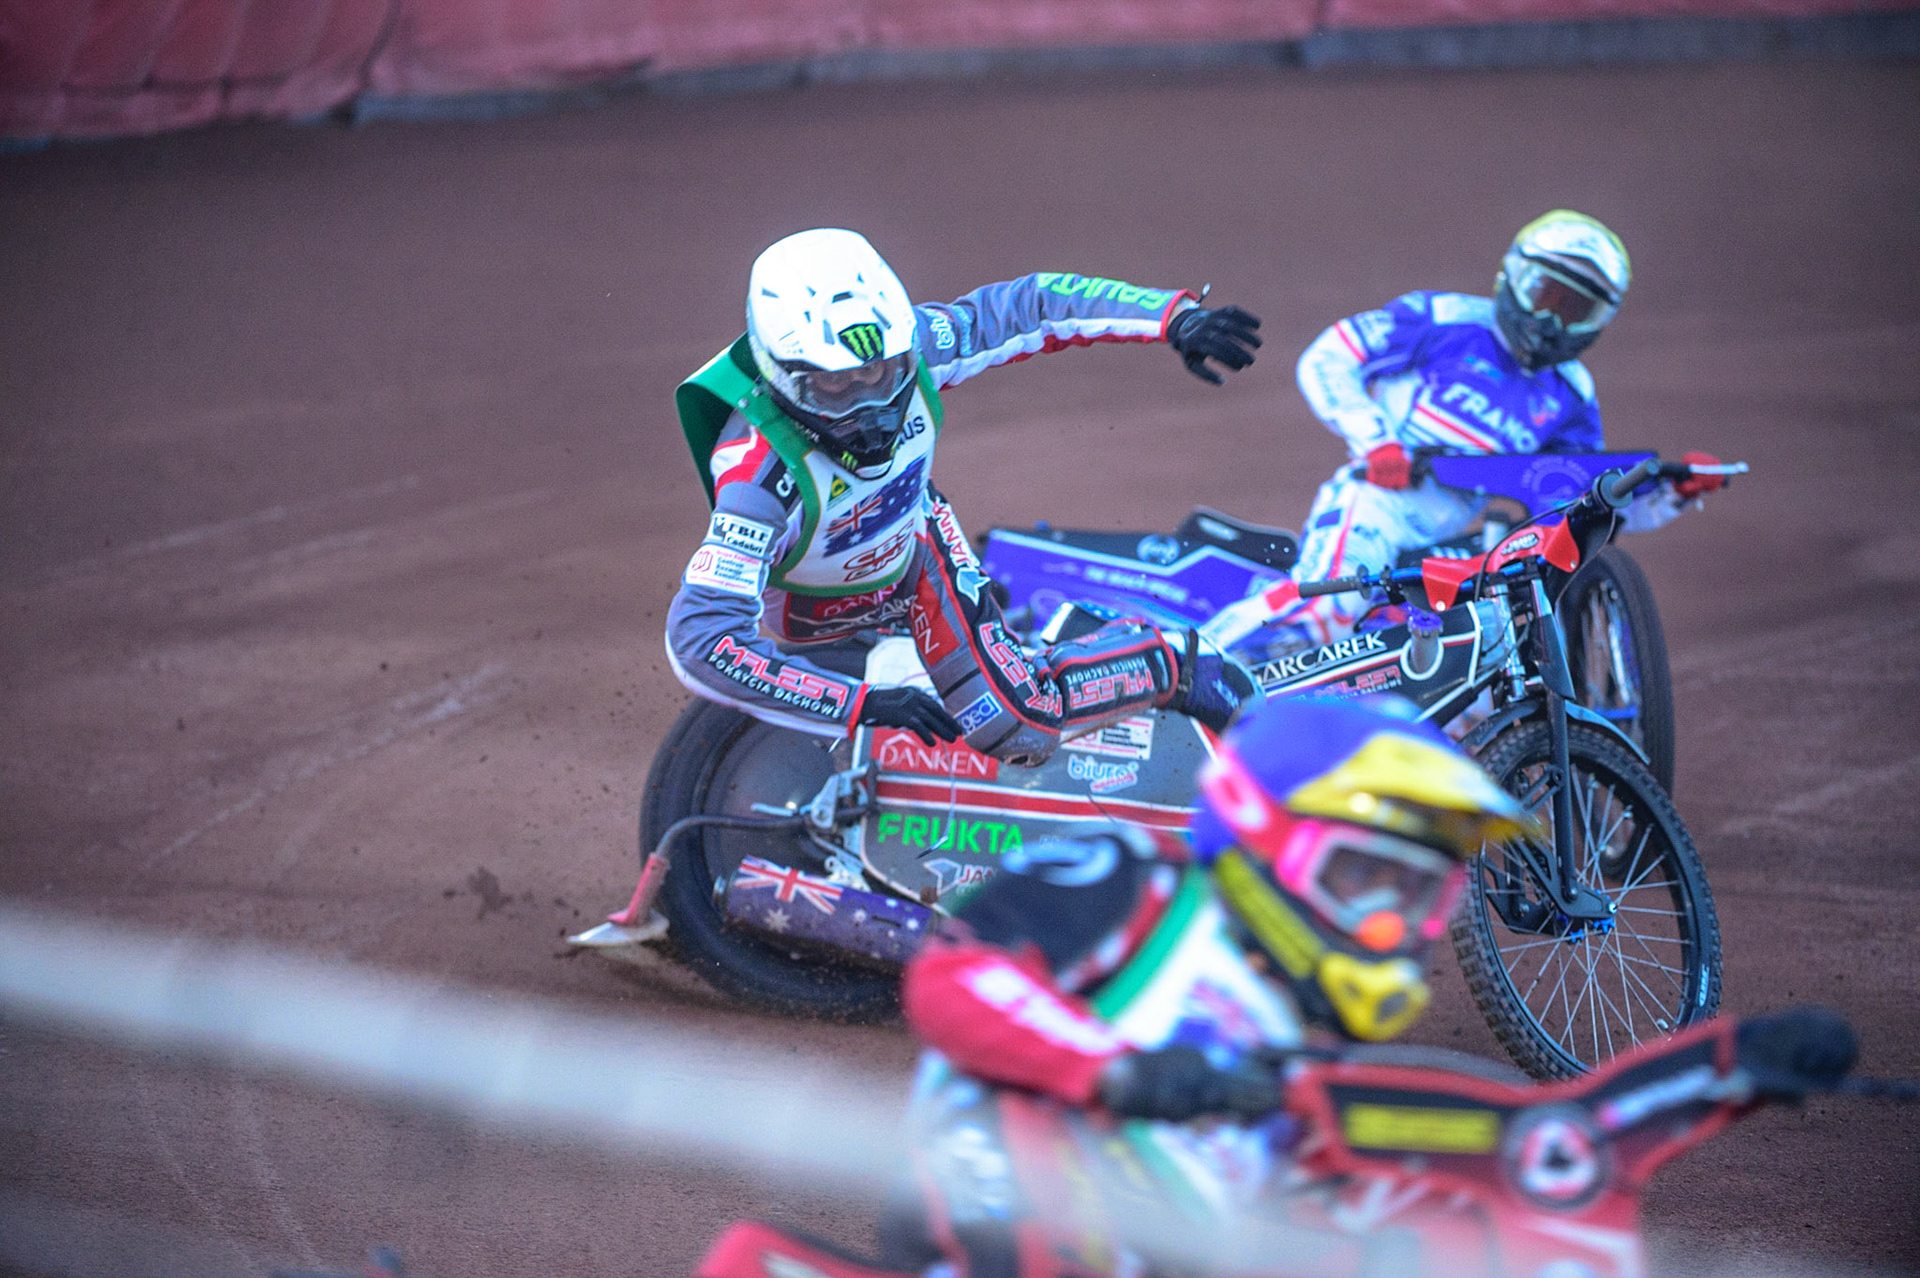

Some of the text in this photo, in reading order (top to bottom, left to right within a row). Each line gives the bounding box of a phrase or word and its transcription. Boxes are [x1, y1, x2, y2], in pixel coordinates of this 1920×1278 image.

[708, 655, 842, 719] POKRYCIA DACHOWE
[713, 636, 849, 708] MALESA
[879, 746, 989, 776] DANKEN
[878, 812, 1024, 855] FRUKTA
